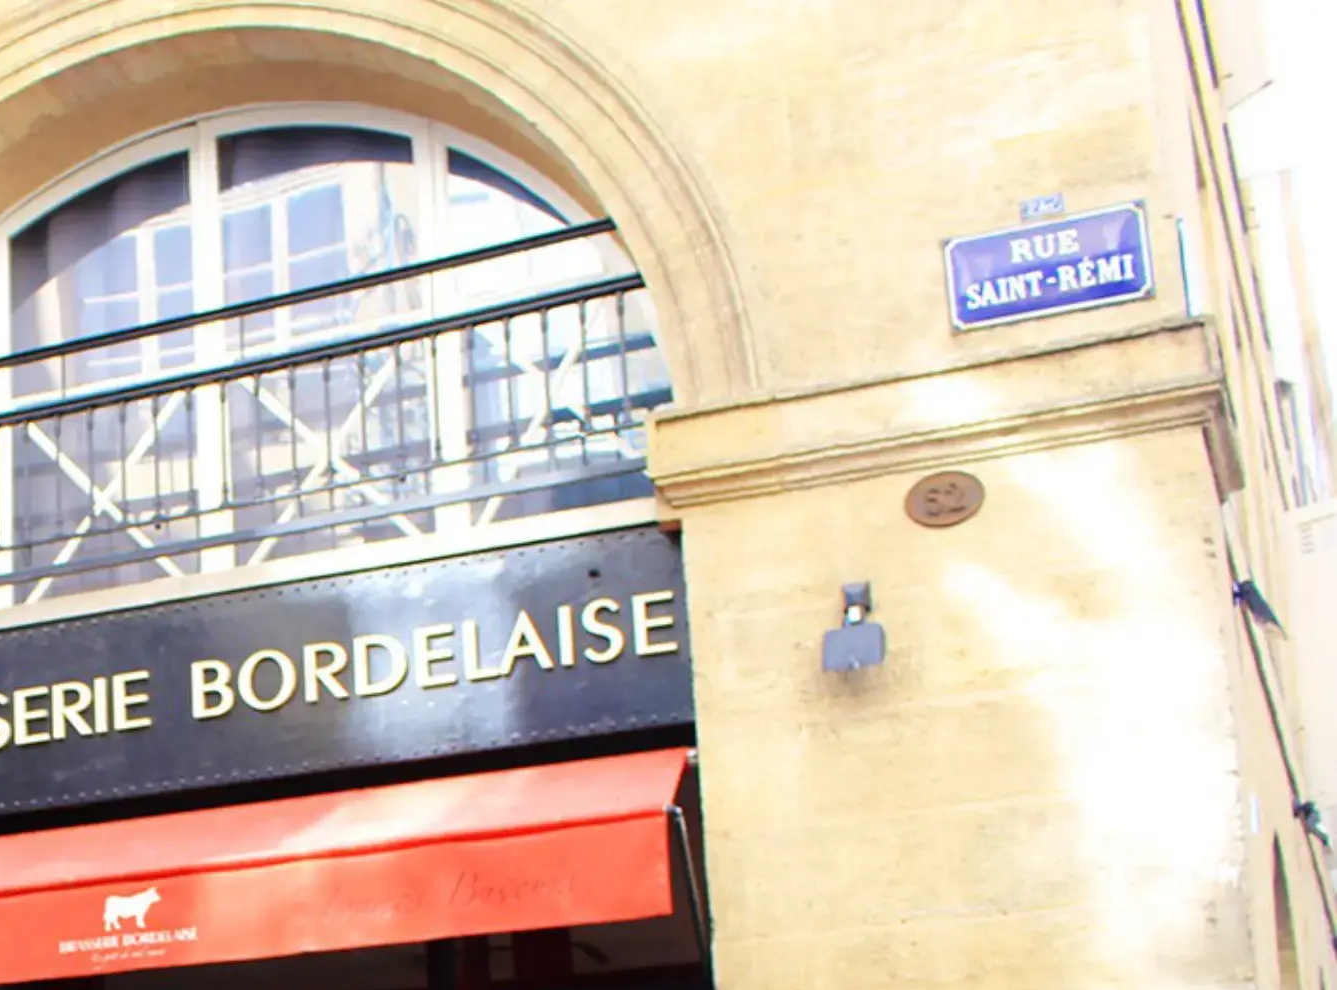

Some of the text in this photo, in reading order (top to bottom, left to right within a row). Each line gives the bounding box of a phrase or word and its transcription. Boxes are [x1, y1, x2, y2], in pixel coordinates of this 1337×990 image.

[1009, 228, 1080, 264] RUE
[966, 253, 1136, 311] SAINT-RÉMI
[190, 590, 679, 720] BORDELAISE
